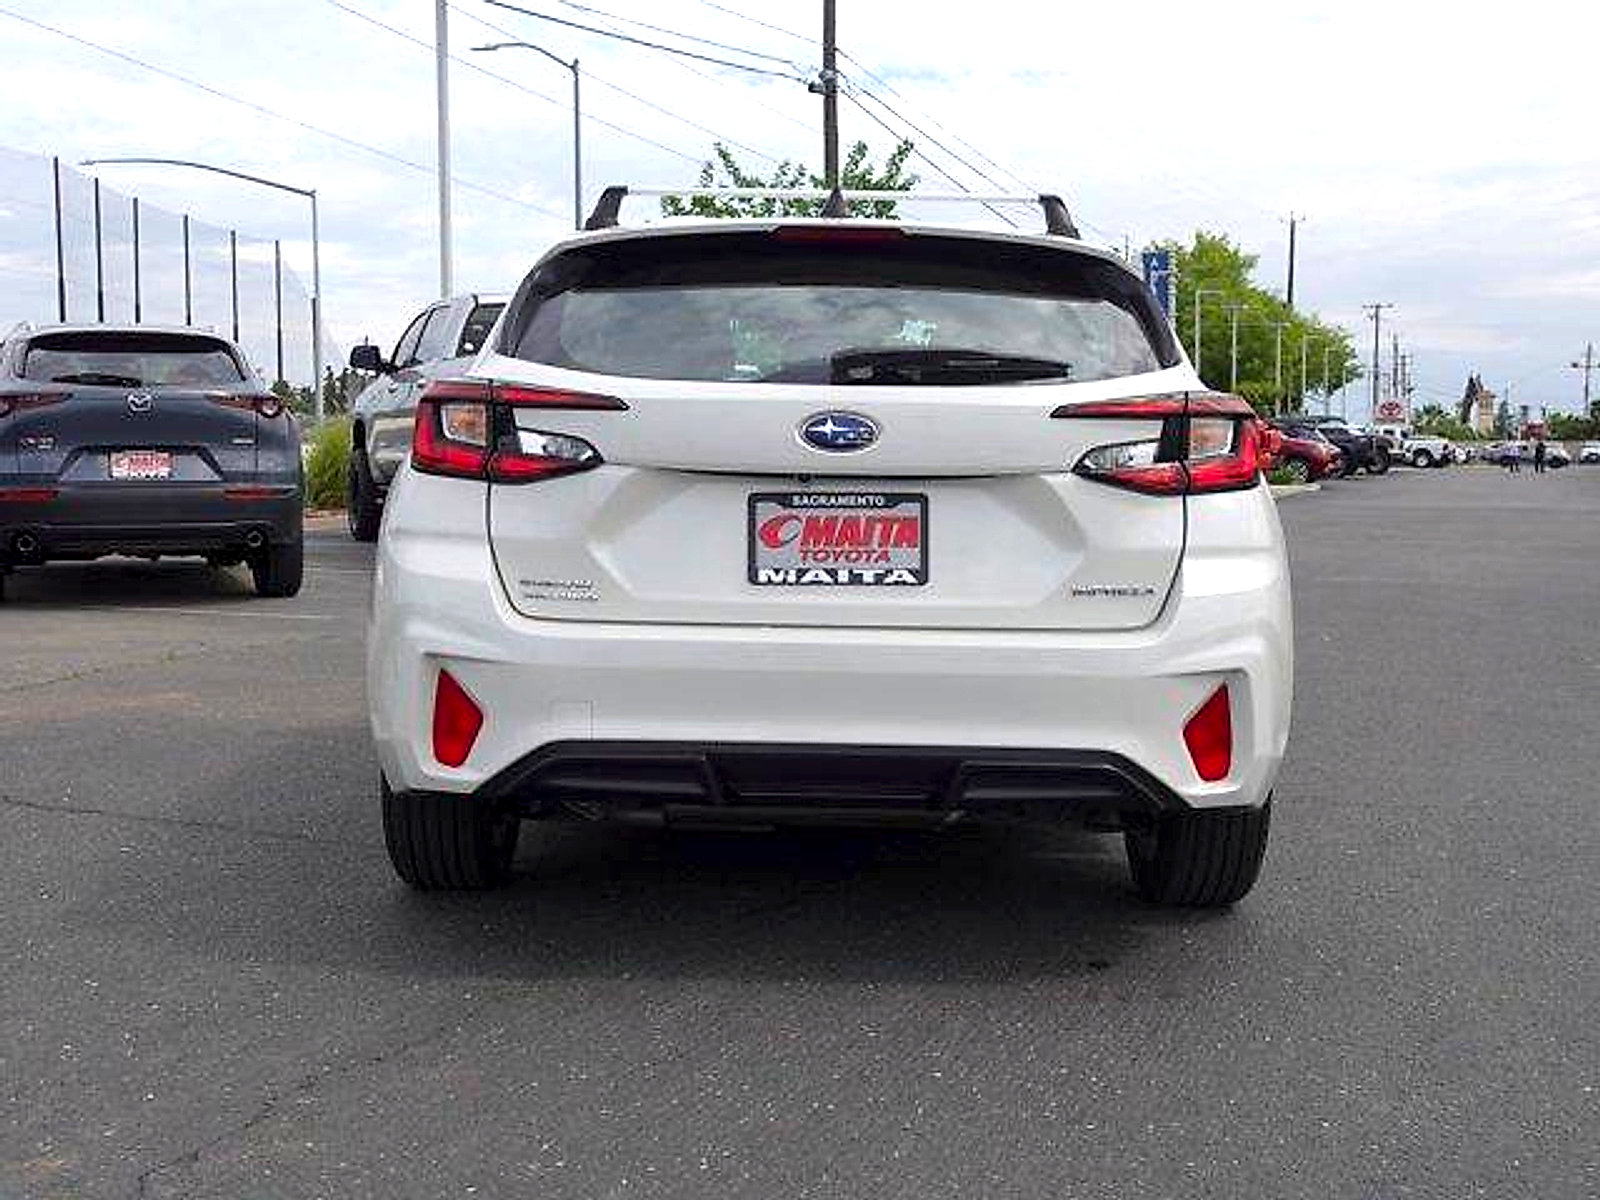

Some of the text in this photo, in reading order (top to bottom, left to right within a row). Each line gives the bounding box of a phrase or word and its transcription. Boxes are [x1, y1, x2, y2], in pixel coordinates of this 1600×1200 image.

[792, 494, 884, 507] SACRAMENTO
[801, 516, 919, 548] MAITA
[800, 549, 891, 564] TOYOTA
[758, 569, 919, 584] MAITA
